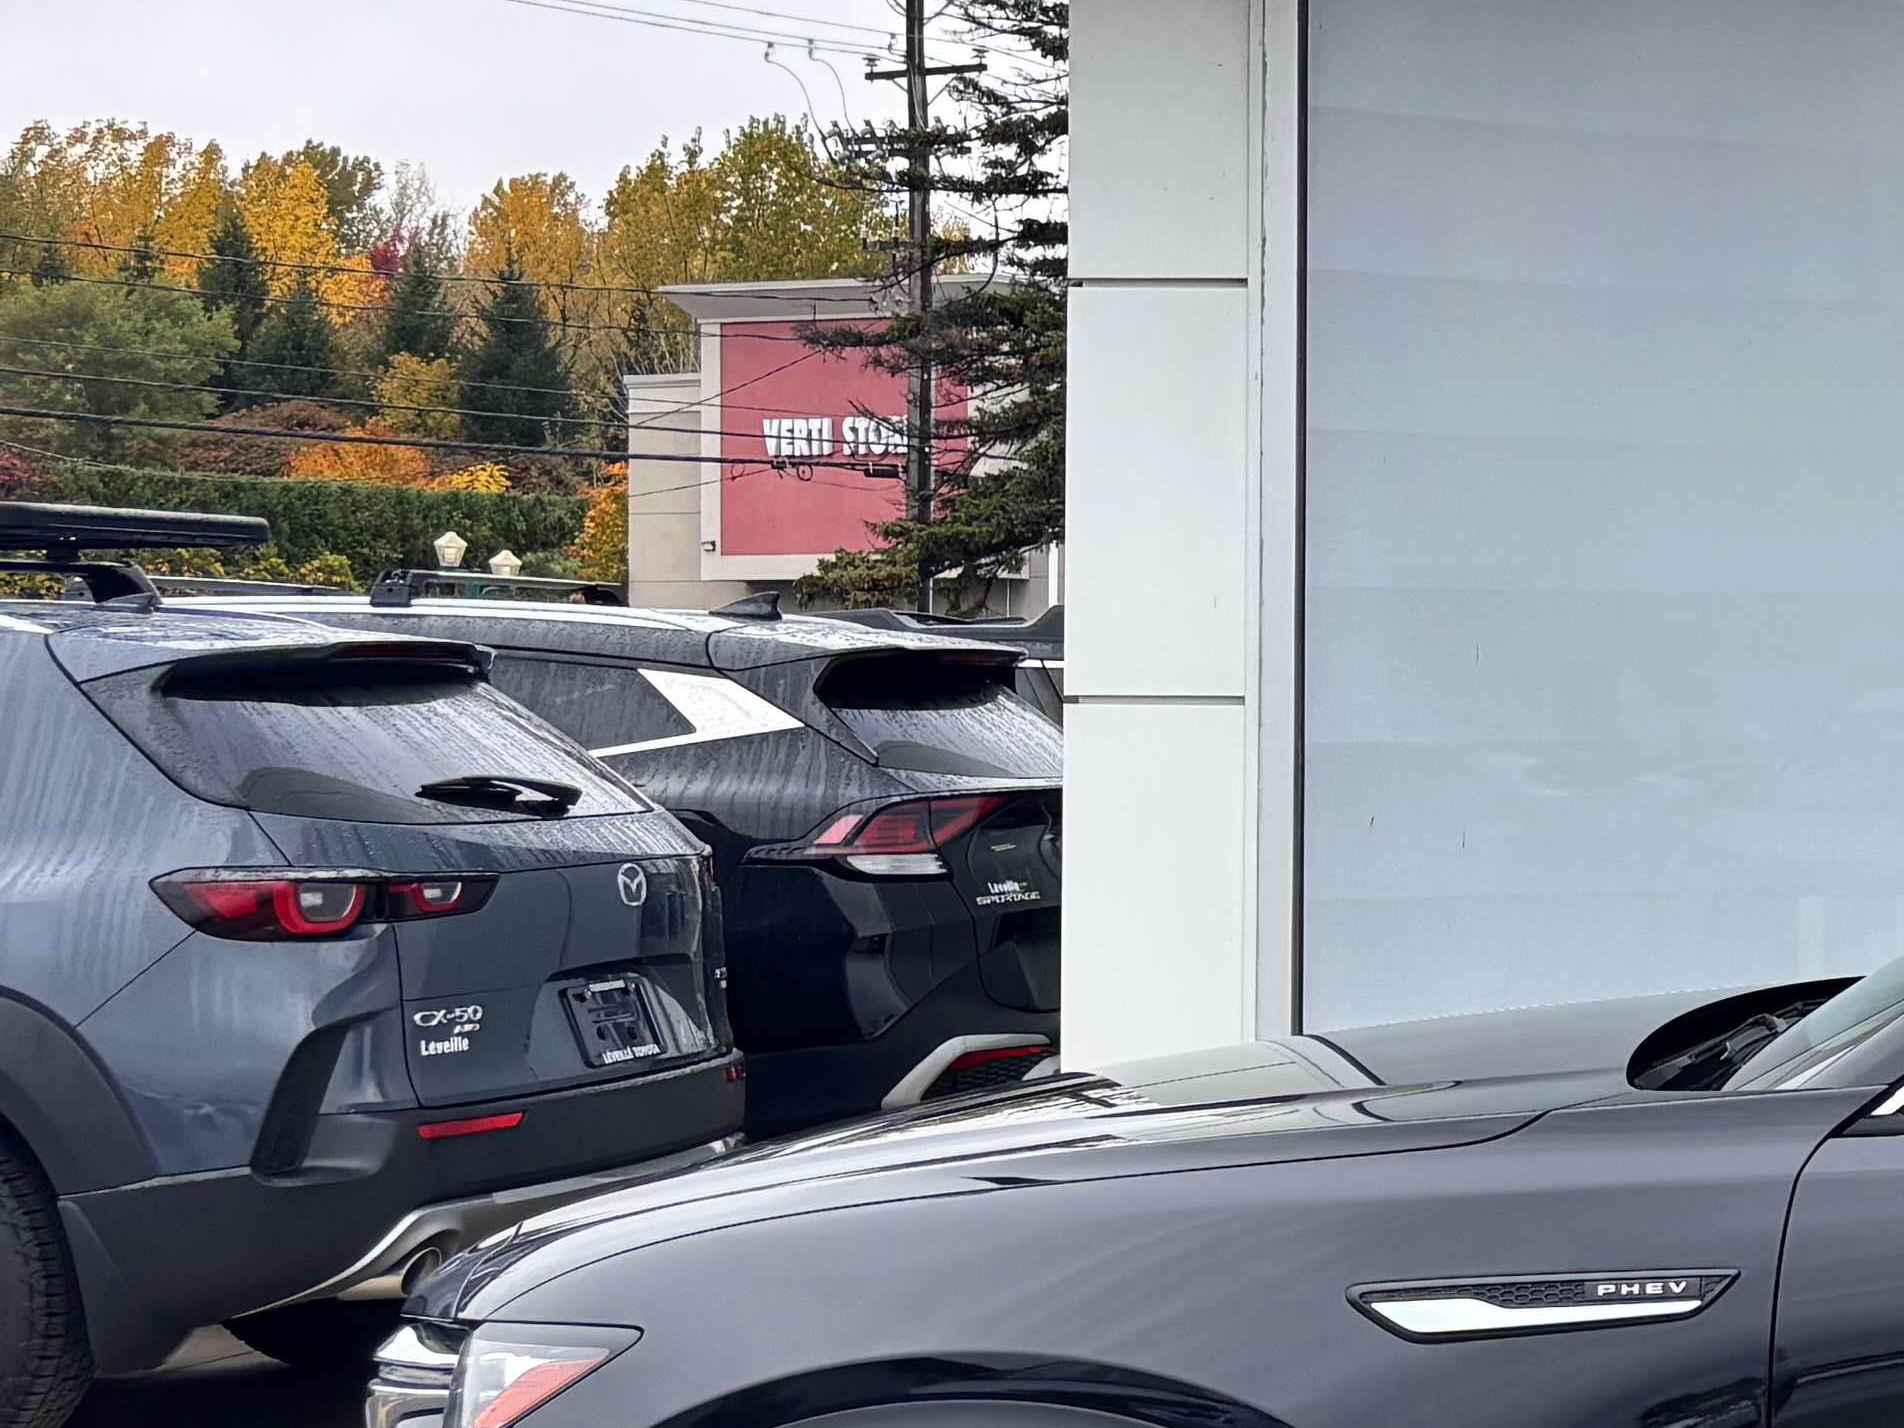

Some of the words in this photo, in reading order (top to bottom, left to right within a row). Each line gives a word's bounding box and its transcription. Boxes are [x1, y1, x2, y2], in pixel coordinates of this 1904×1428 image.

[763, 417, 834, 457] VERTI
[413, 1004, 483, 1027] CX-50
[1596, 1279, 1689, 1298] PHEV
